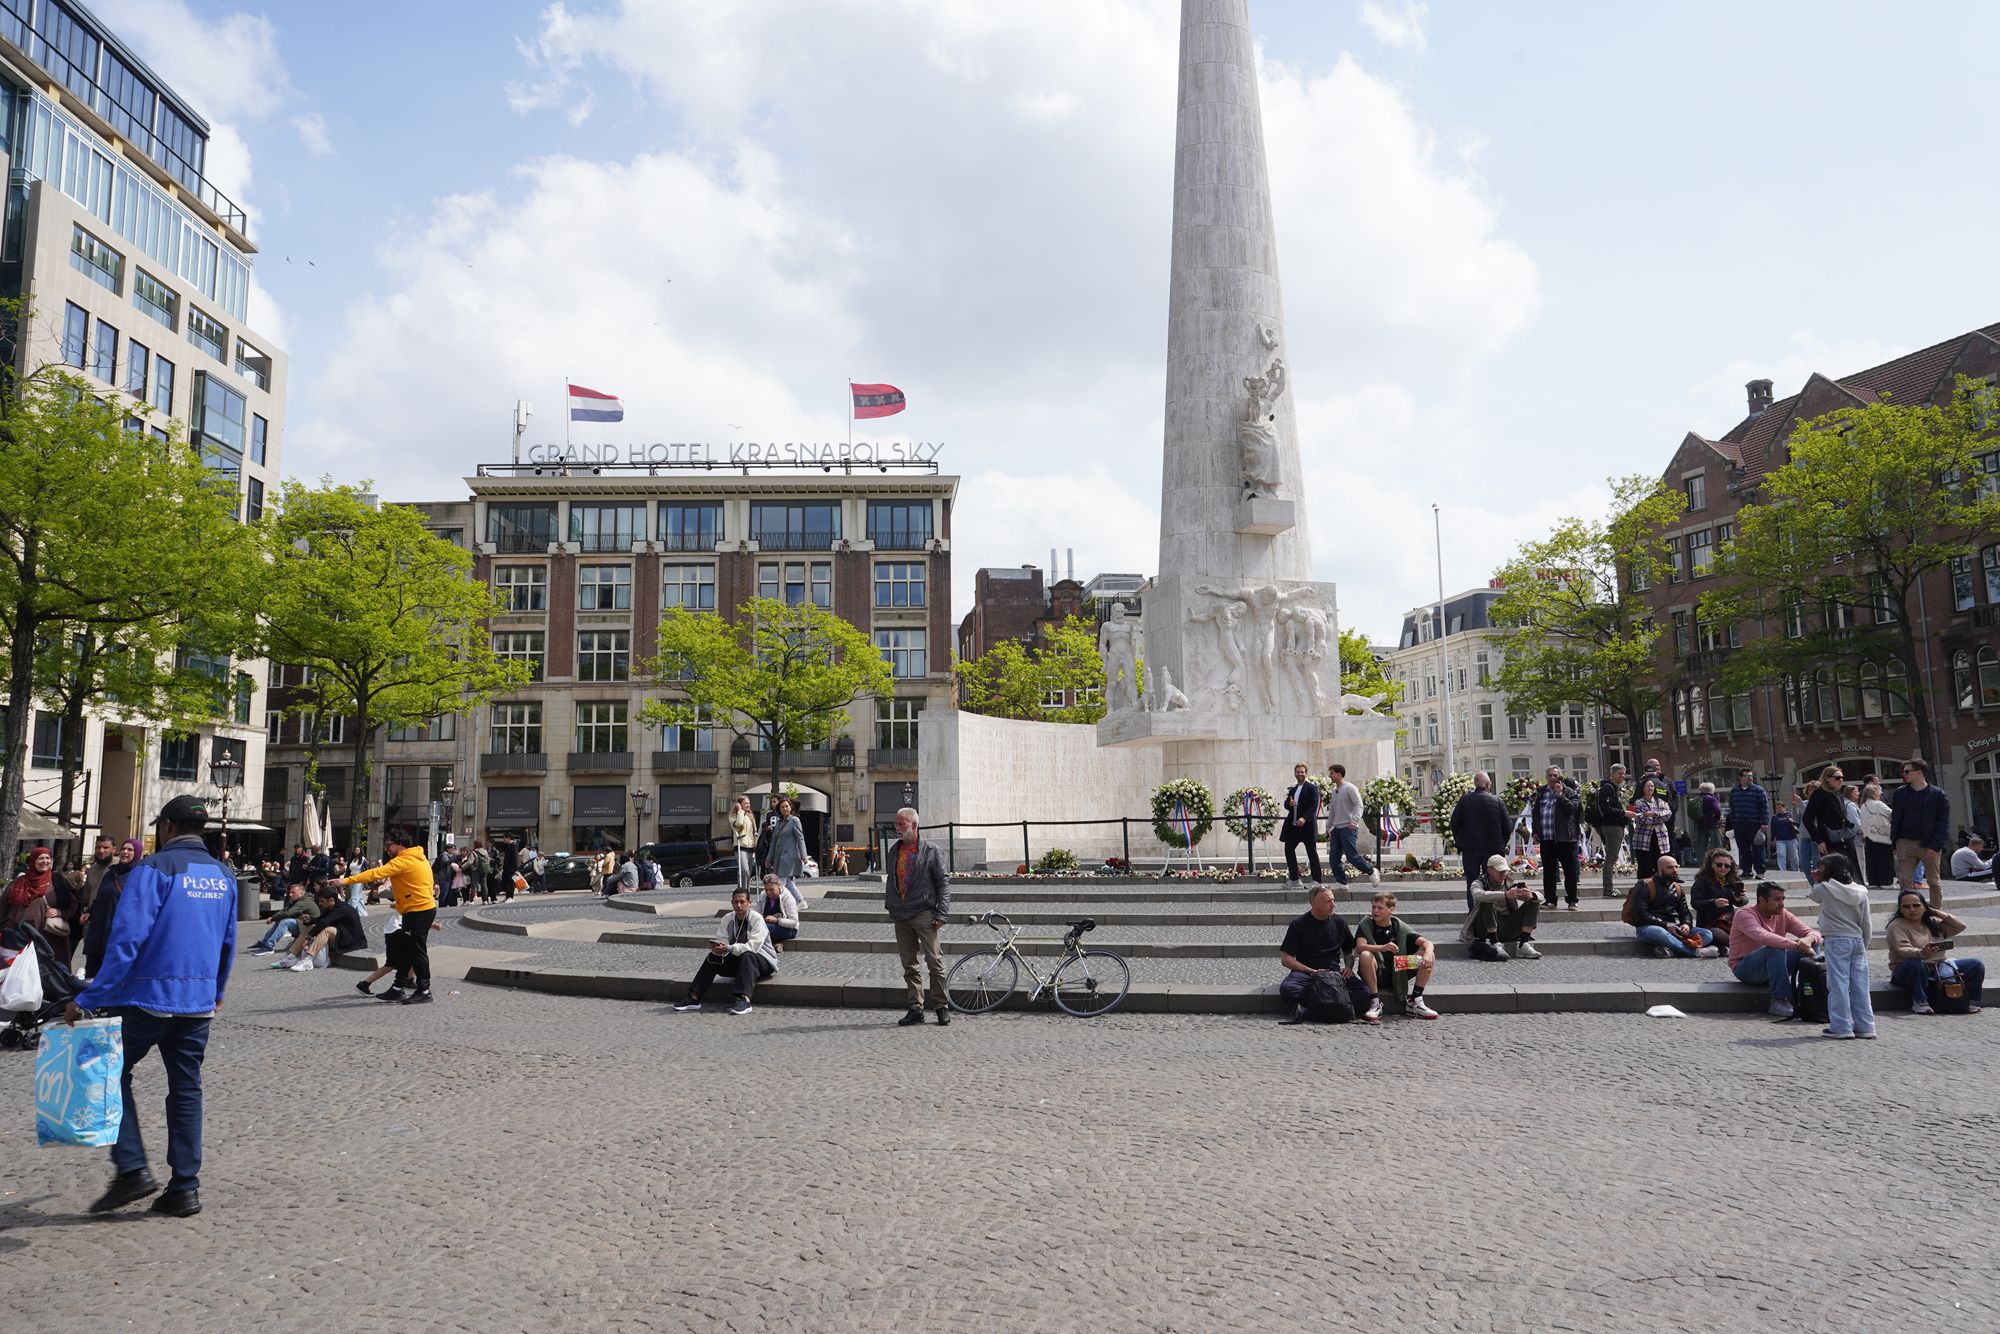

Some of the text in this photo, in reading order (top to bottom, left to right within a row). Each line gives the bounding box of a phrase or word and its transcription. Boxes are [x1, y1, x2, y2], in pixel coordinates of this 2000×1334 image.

[528, 442, 945, 464] GRAND HOTEL KRASNAPOLSKY
